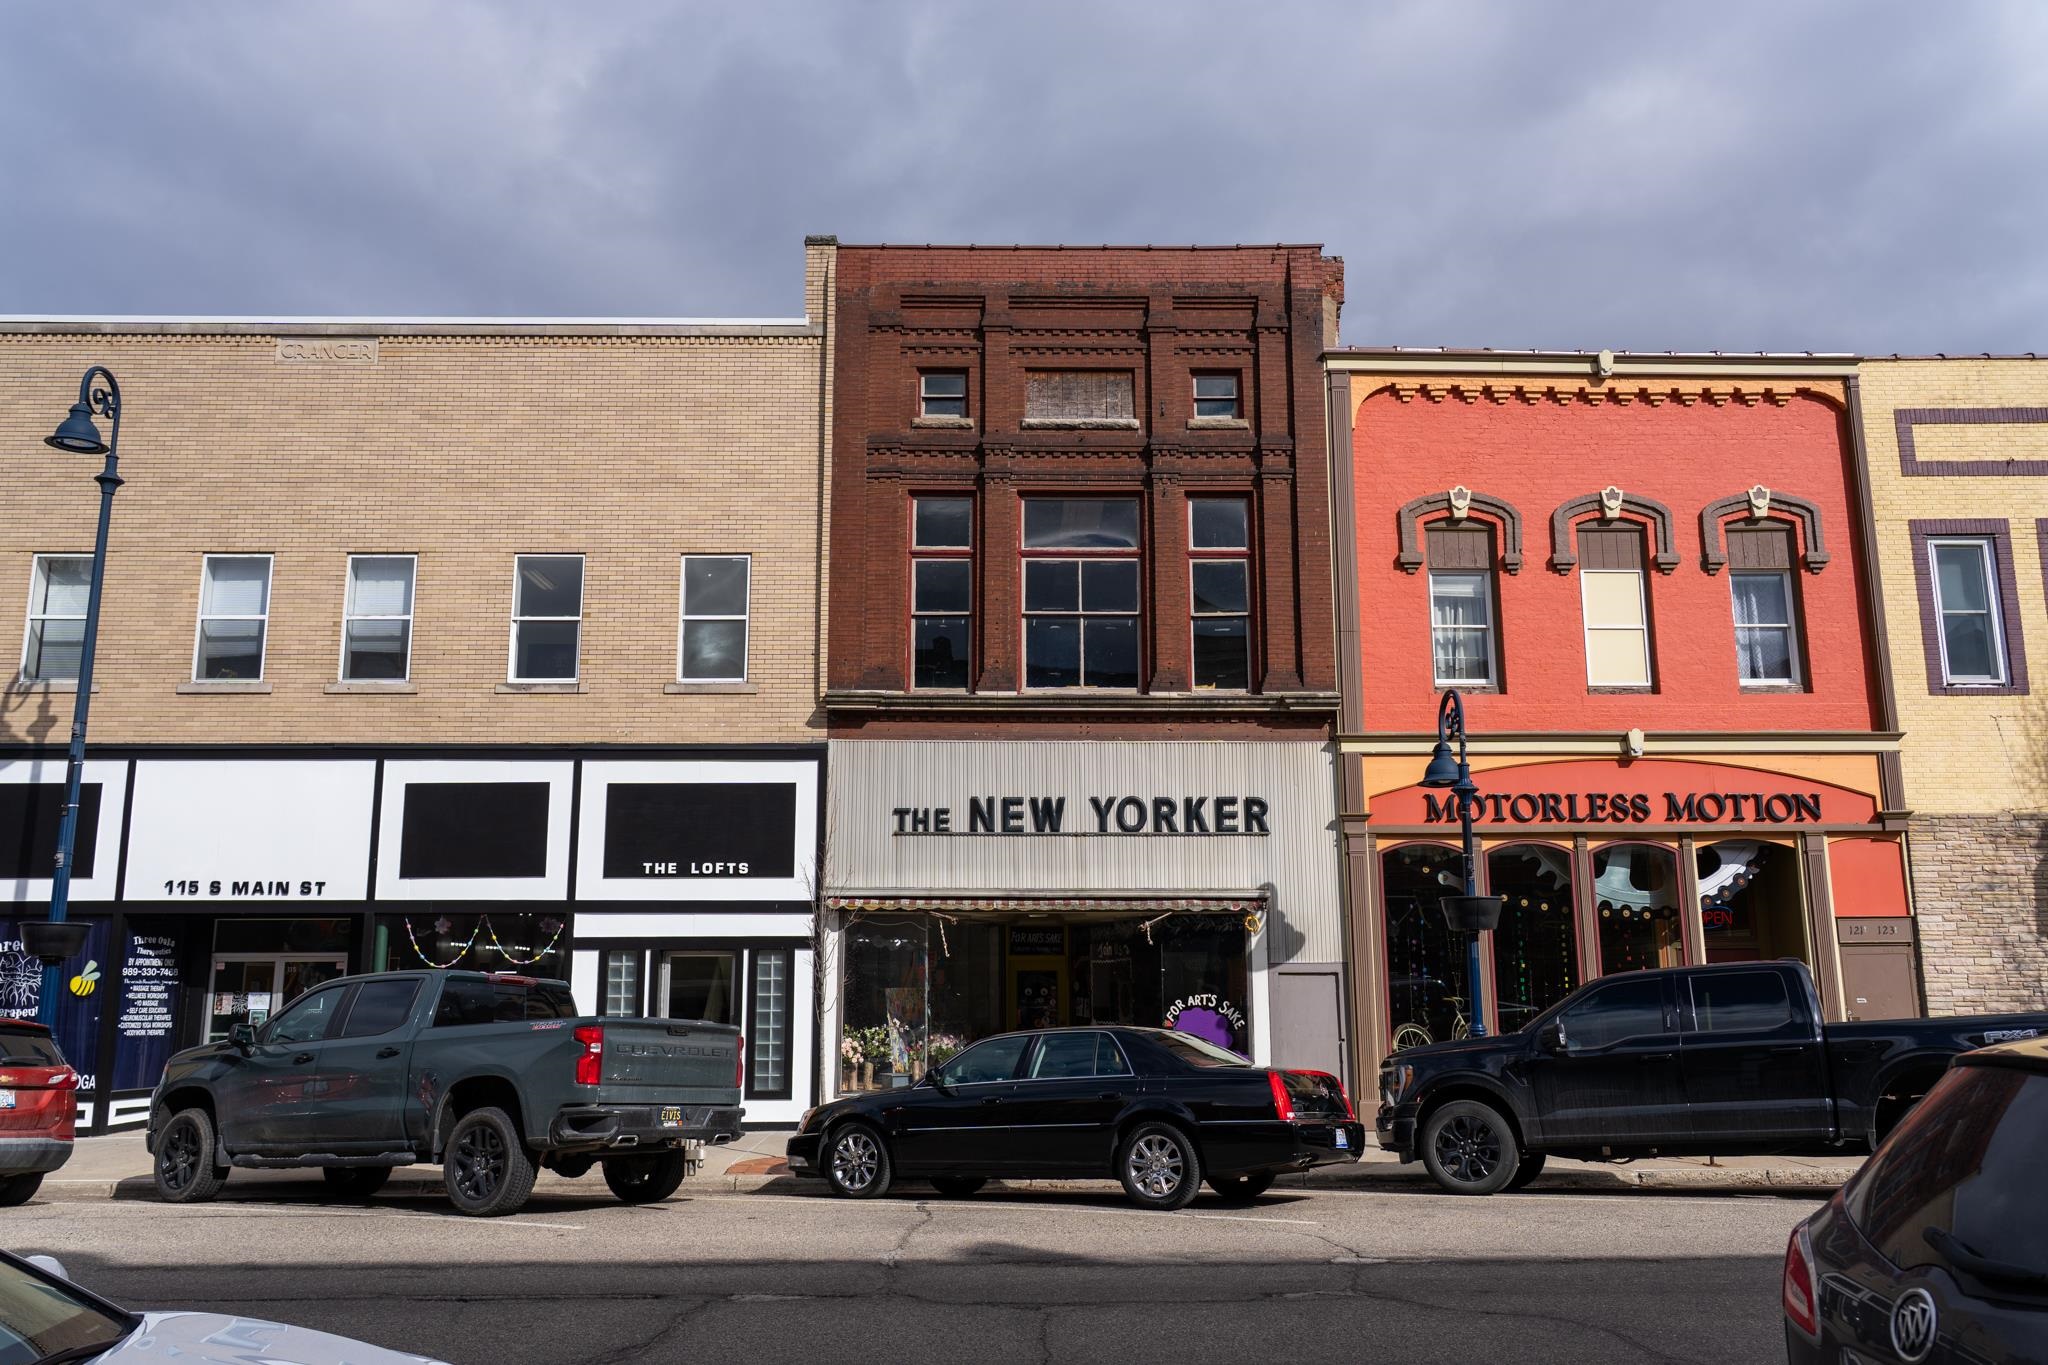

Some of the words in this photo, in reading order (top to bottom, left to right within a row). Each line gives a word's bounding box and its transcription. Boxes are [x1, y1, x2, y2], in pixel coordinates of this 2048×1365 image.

[892, 807, 951, 832] THE
[968, 795, 1067, 832] NEW
[1088, 795, 1270, 832] YORKER
[1423, 793, 1651, 824] MOTORLESS
[1664, 792, 1822, 824] MOTION
[643, 862, 678, 874] THE
[690, 862, 749, 874] LOFTS
[164, 880, 199, 896] 115
[209, 880, 222, 896] S
[231, 881, 290, 896] MAIN
[299, 881, 327, 896] ST
[1702, 911, 1733, 925] PEN
[1166, 1000, 1186, 1022] FOR
[1187, 993, 1217, 1007] ART'S
[1218, 1001, 1245, 1030] SAKE
[616, 1043, 731, 1057] CHEVROLET
